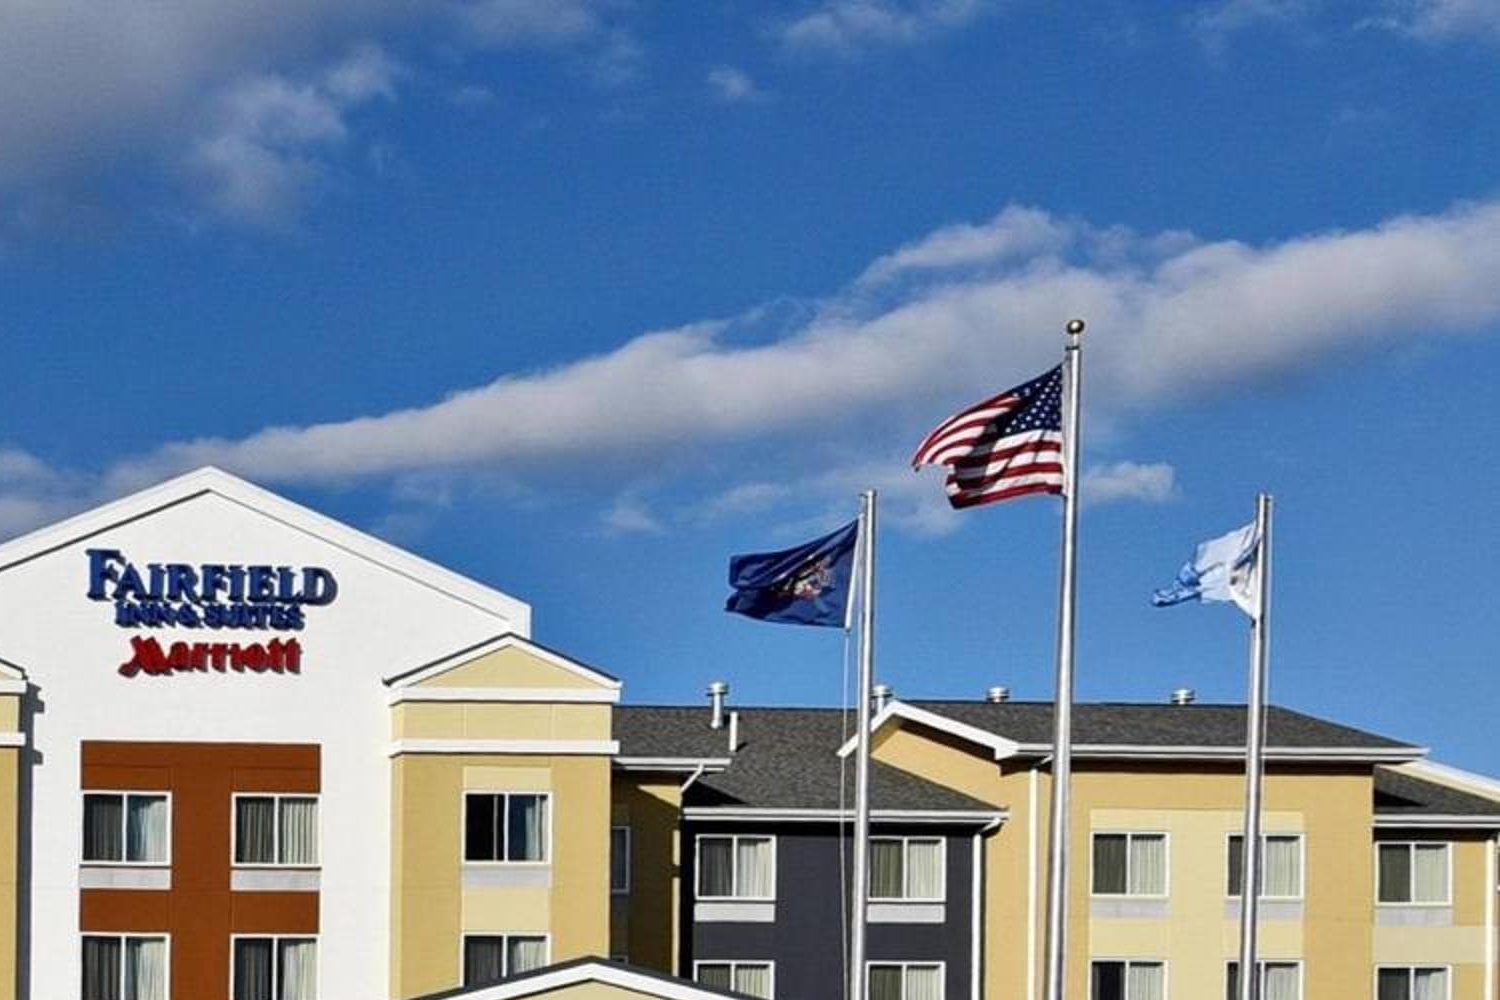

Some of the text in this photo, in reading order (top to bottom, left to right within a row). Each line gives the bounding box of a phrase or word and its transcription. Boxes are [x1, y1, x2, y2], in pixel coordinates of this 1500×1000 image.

[85, 548, 338, 606] FAIRFIELD
[114, 601, 306, 631] INN & SUITES
[118, 634, 303, 678] Marriott
